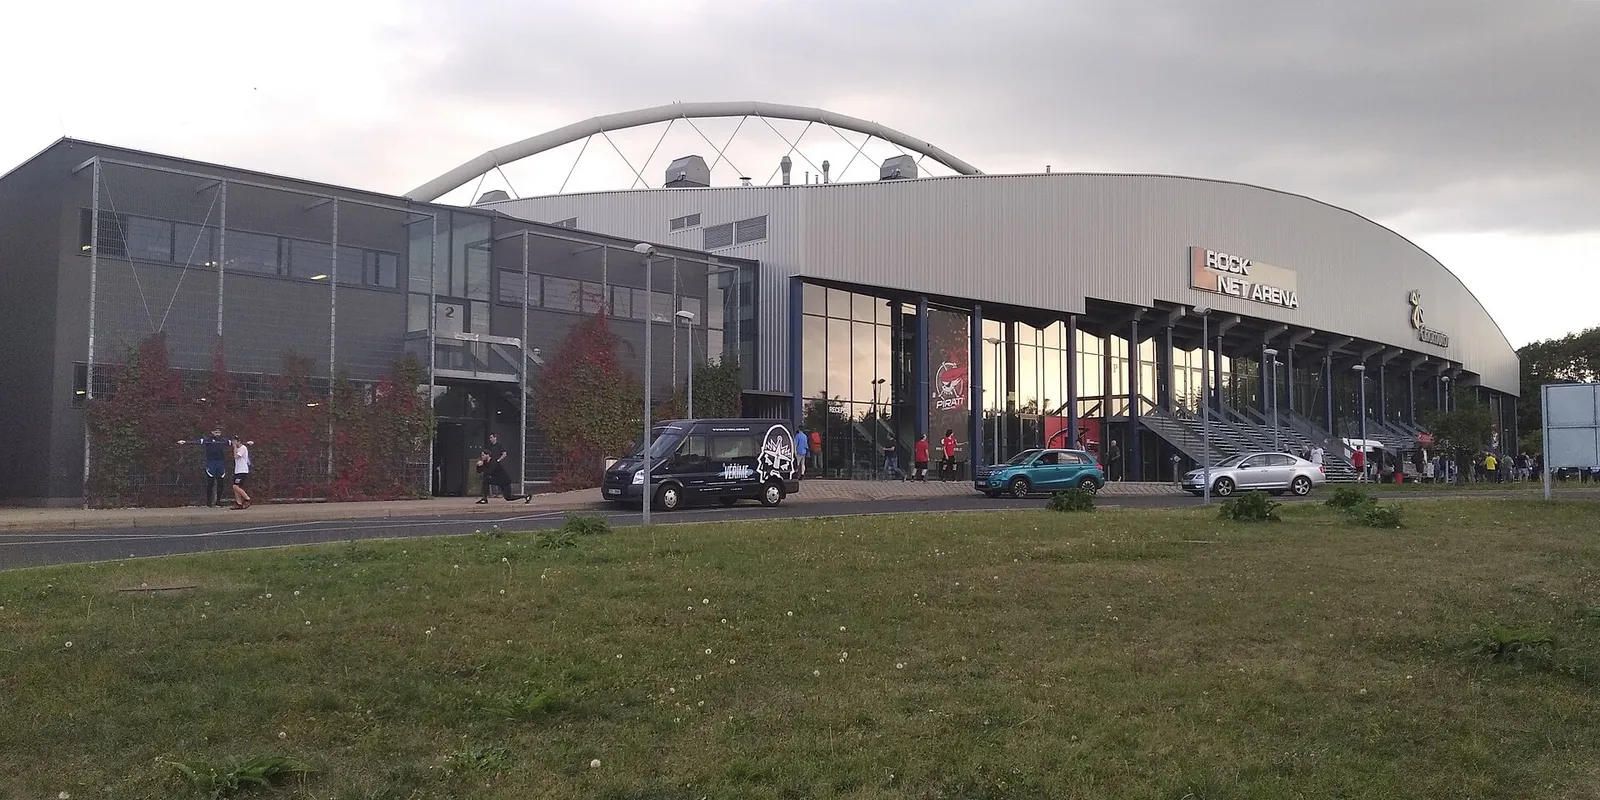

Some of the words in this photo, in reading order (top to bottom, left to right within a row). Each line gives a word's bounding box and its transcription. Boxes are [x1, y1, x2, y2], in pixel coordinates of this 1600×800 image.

[1217, 275, 1250, 298] NET
[1251, 283, 1299, 308] ARENA
[445, 306, 455, 319] 2
